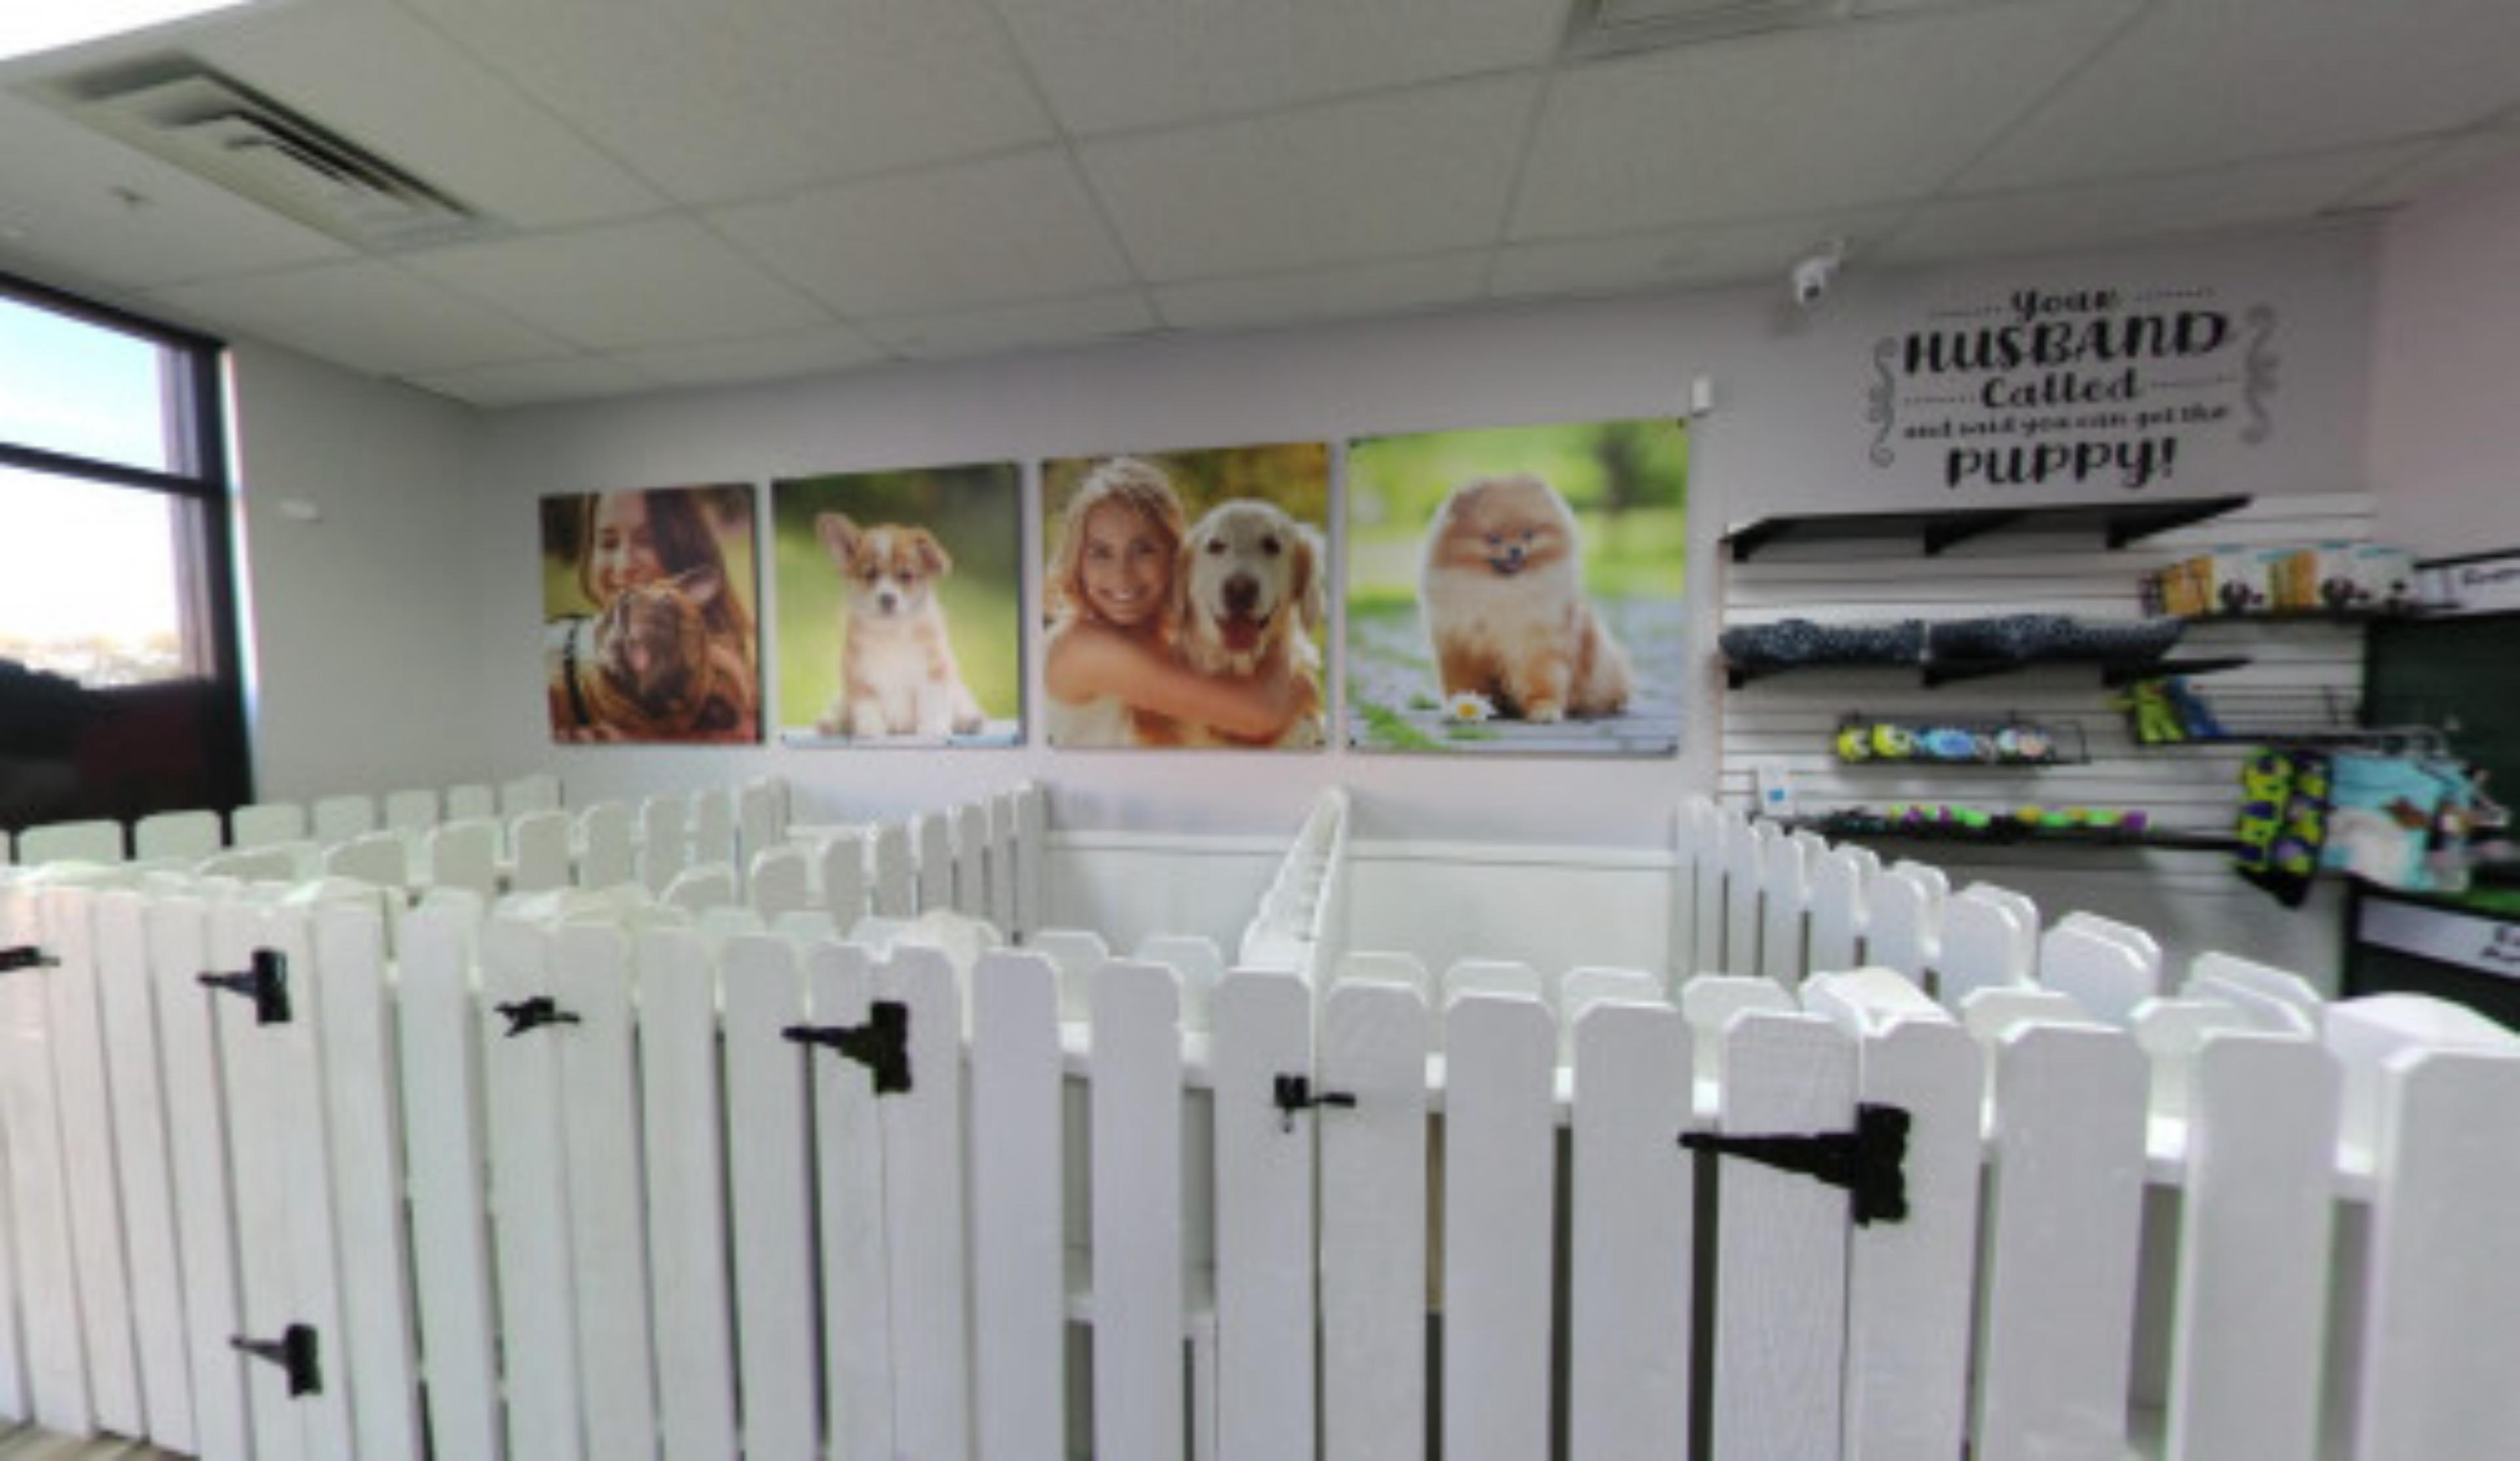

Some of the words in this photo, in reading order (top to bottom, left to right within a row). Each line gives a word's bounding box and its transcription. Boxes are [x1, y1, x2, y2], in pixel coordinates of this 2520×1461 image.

[2011, 289, 2120, 322] Your
[1904, 310, 2229, 375] HUSBAND
[1981, 367, 2138, 409] Called
